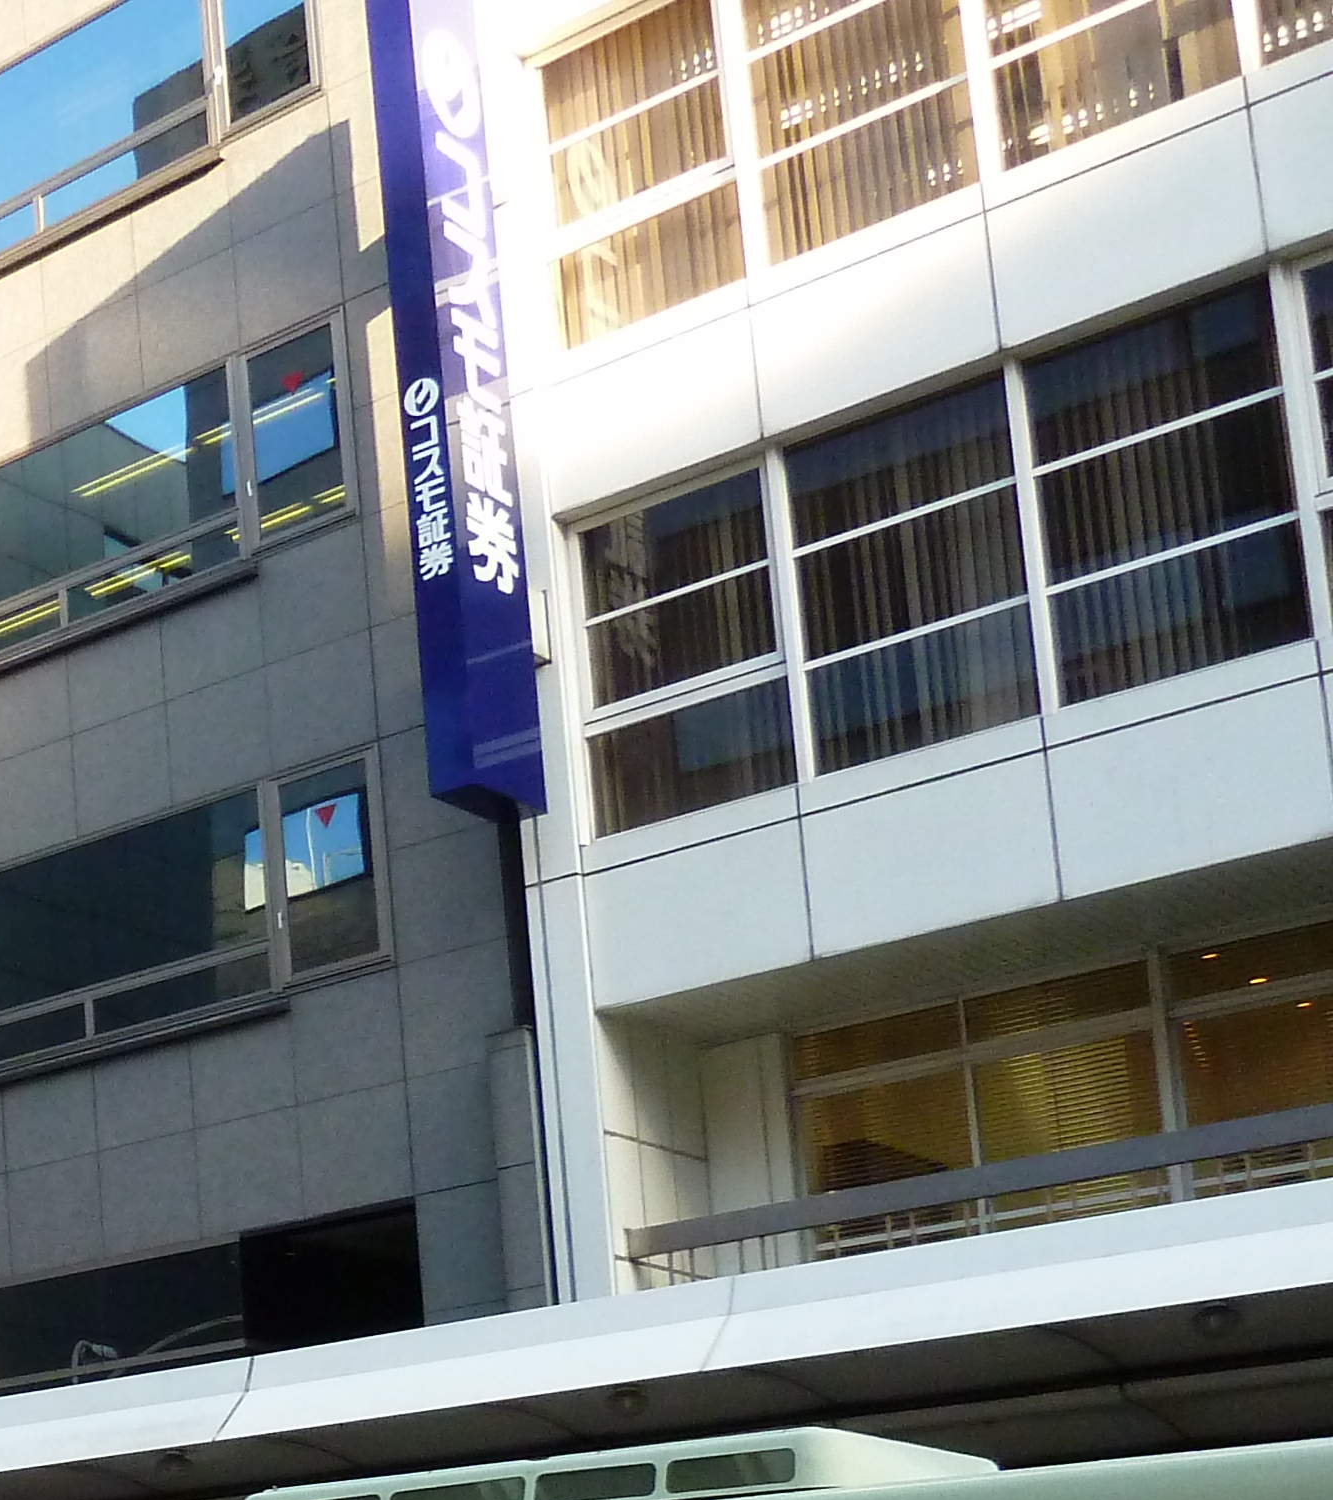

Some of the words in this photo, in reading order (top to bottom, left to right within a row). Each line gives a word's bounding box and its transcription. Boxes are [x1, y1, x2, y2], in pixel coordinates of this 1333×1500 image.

[410, 420, 454, 582] コスモ証券
[436, 128, 520, 595] コスモ証券
